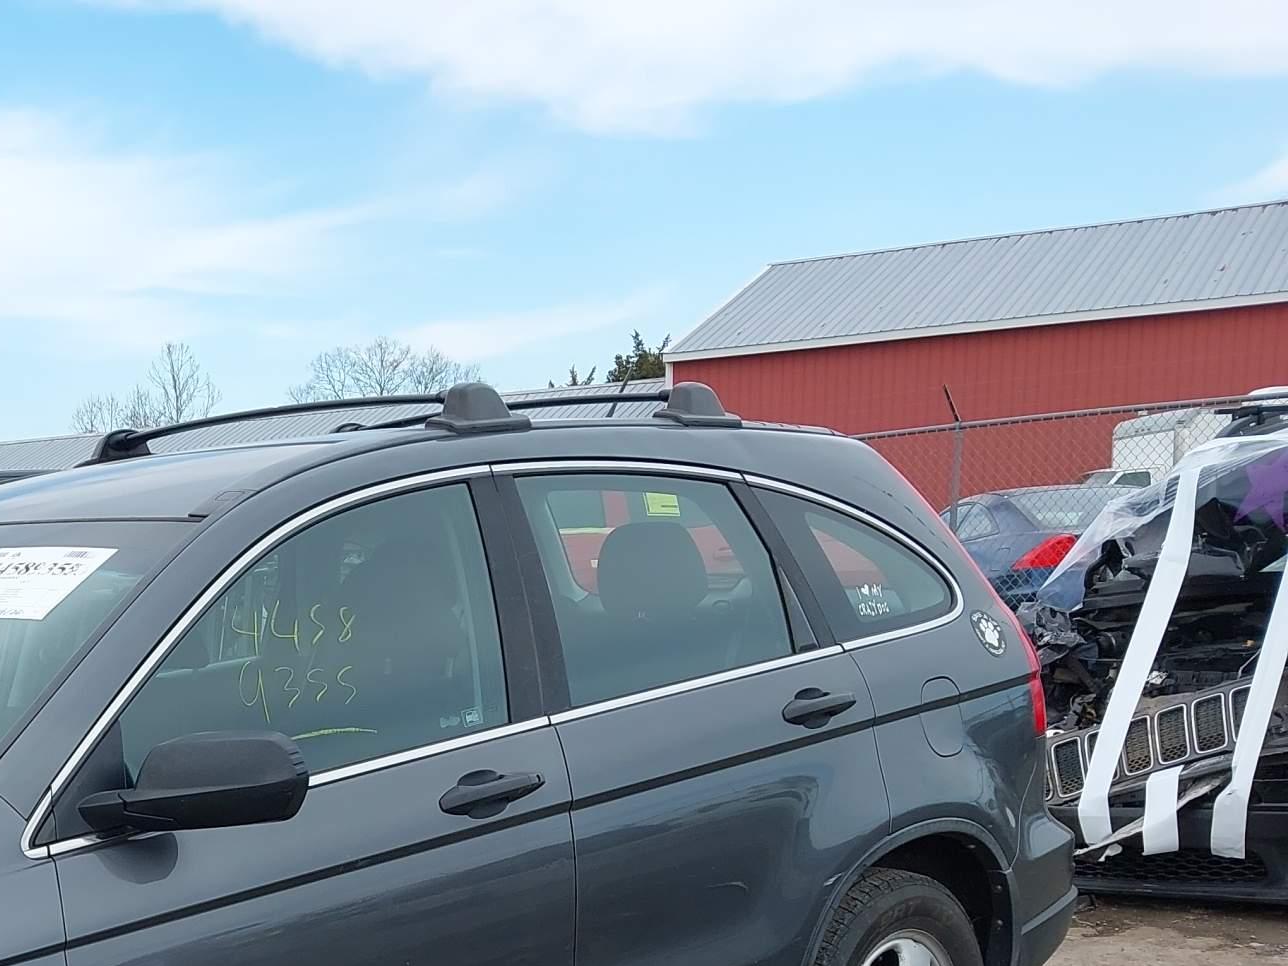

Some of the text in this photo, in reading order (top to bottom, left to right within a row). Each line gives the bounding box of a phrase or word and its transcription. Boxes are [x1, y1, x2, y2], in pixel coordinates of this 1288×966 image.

[871, 583, 882, 598] MY
[858, 599, 878, 616] CRAZY
[238, 661, 357, 724] 9355
